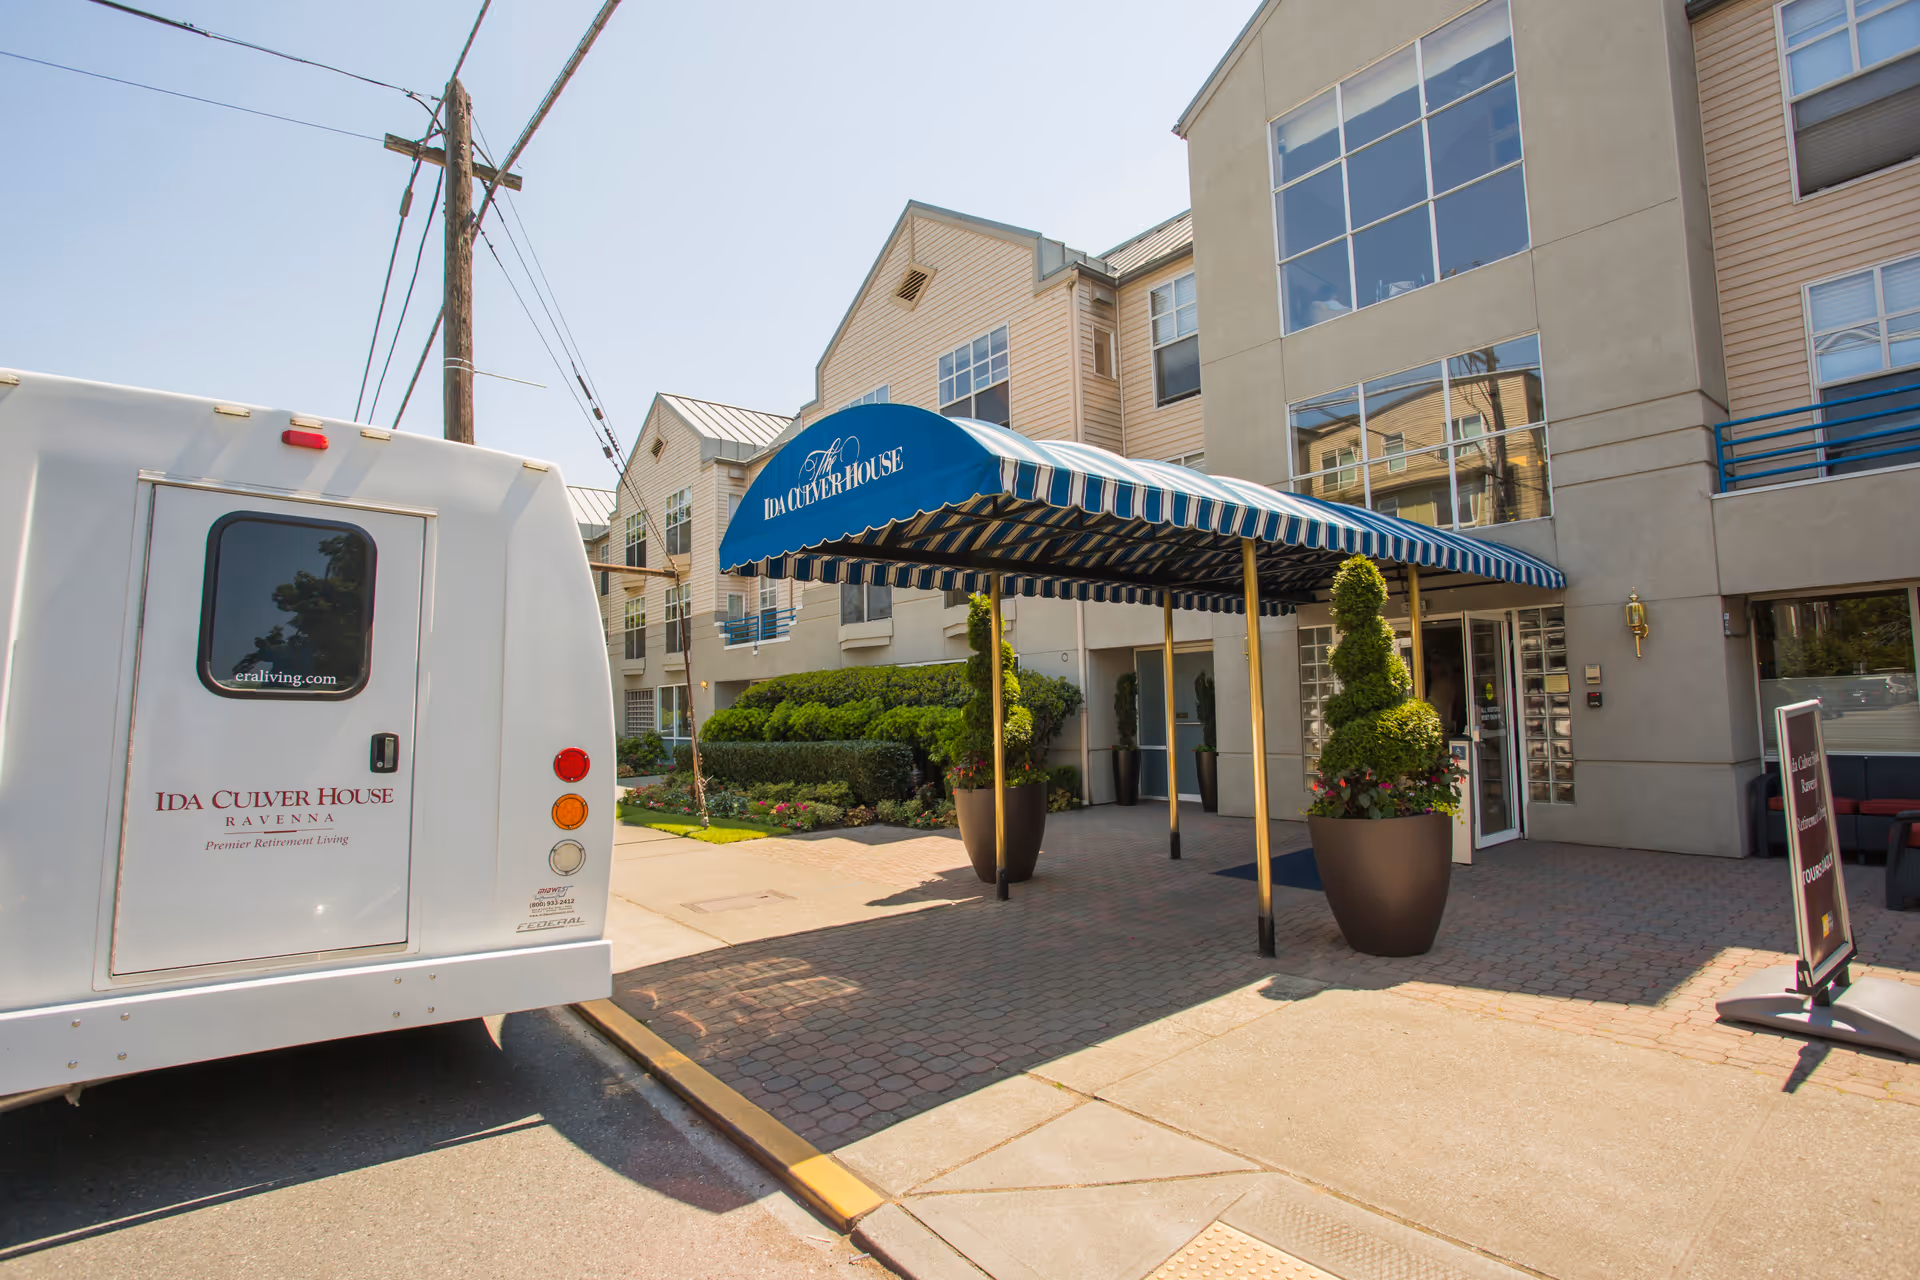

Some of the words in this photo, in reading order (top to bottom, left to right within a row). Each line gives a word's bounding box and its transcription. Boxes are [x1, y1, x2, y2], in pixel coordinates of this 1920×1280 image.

[764, 495, 786, 521] IDA
[787, 472, 843, 511] CULVER
[844, 446, 904, 491] HOUSE
[235, 669, 337, 687] eraliving.com
[155, 791, 204, 811] IDA
[211, 789, 311, 809] CULVER
[317, 787, 394, 806] HOUSE
[225, 813, 334, 827] RAVENNA
[205, 839, 251, 851] Premier
[254, 836, 314, 849] Retirement
[316, 834, 349, 847] Living
[1802, 861, 1822, 886] TOURS
[517, 916, 585, 930] FEDERAL
